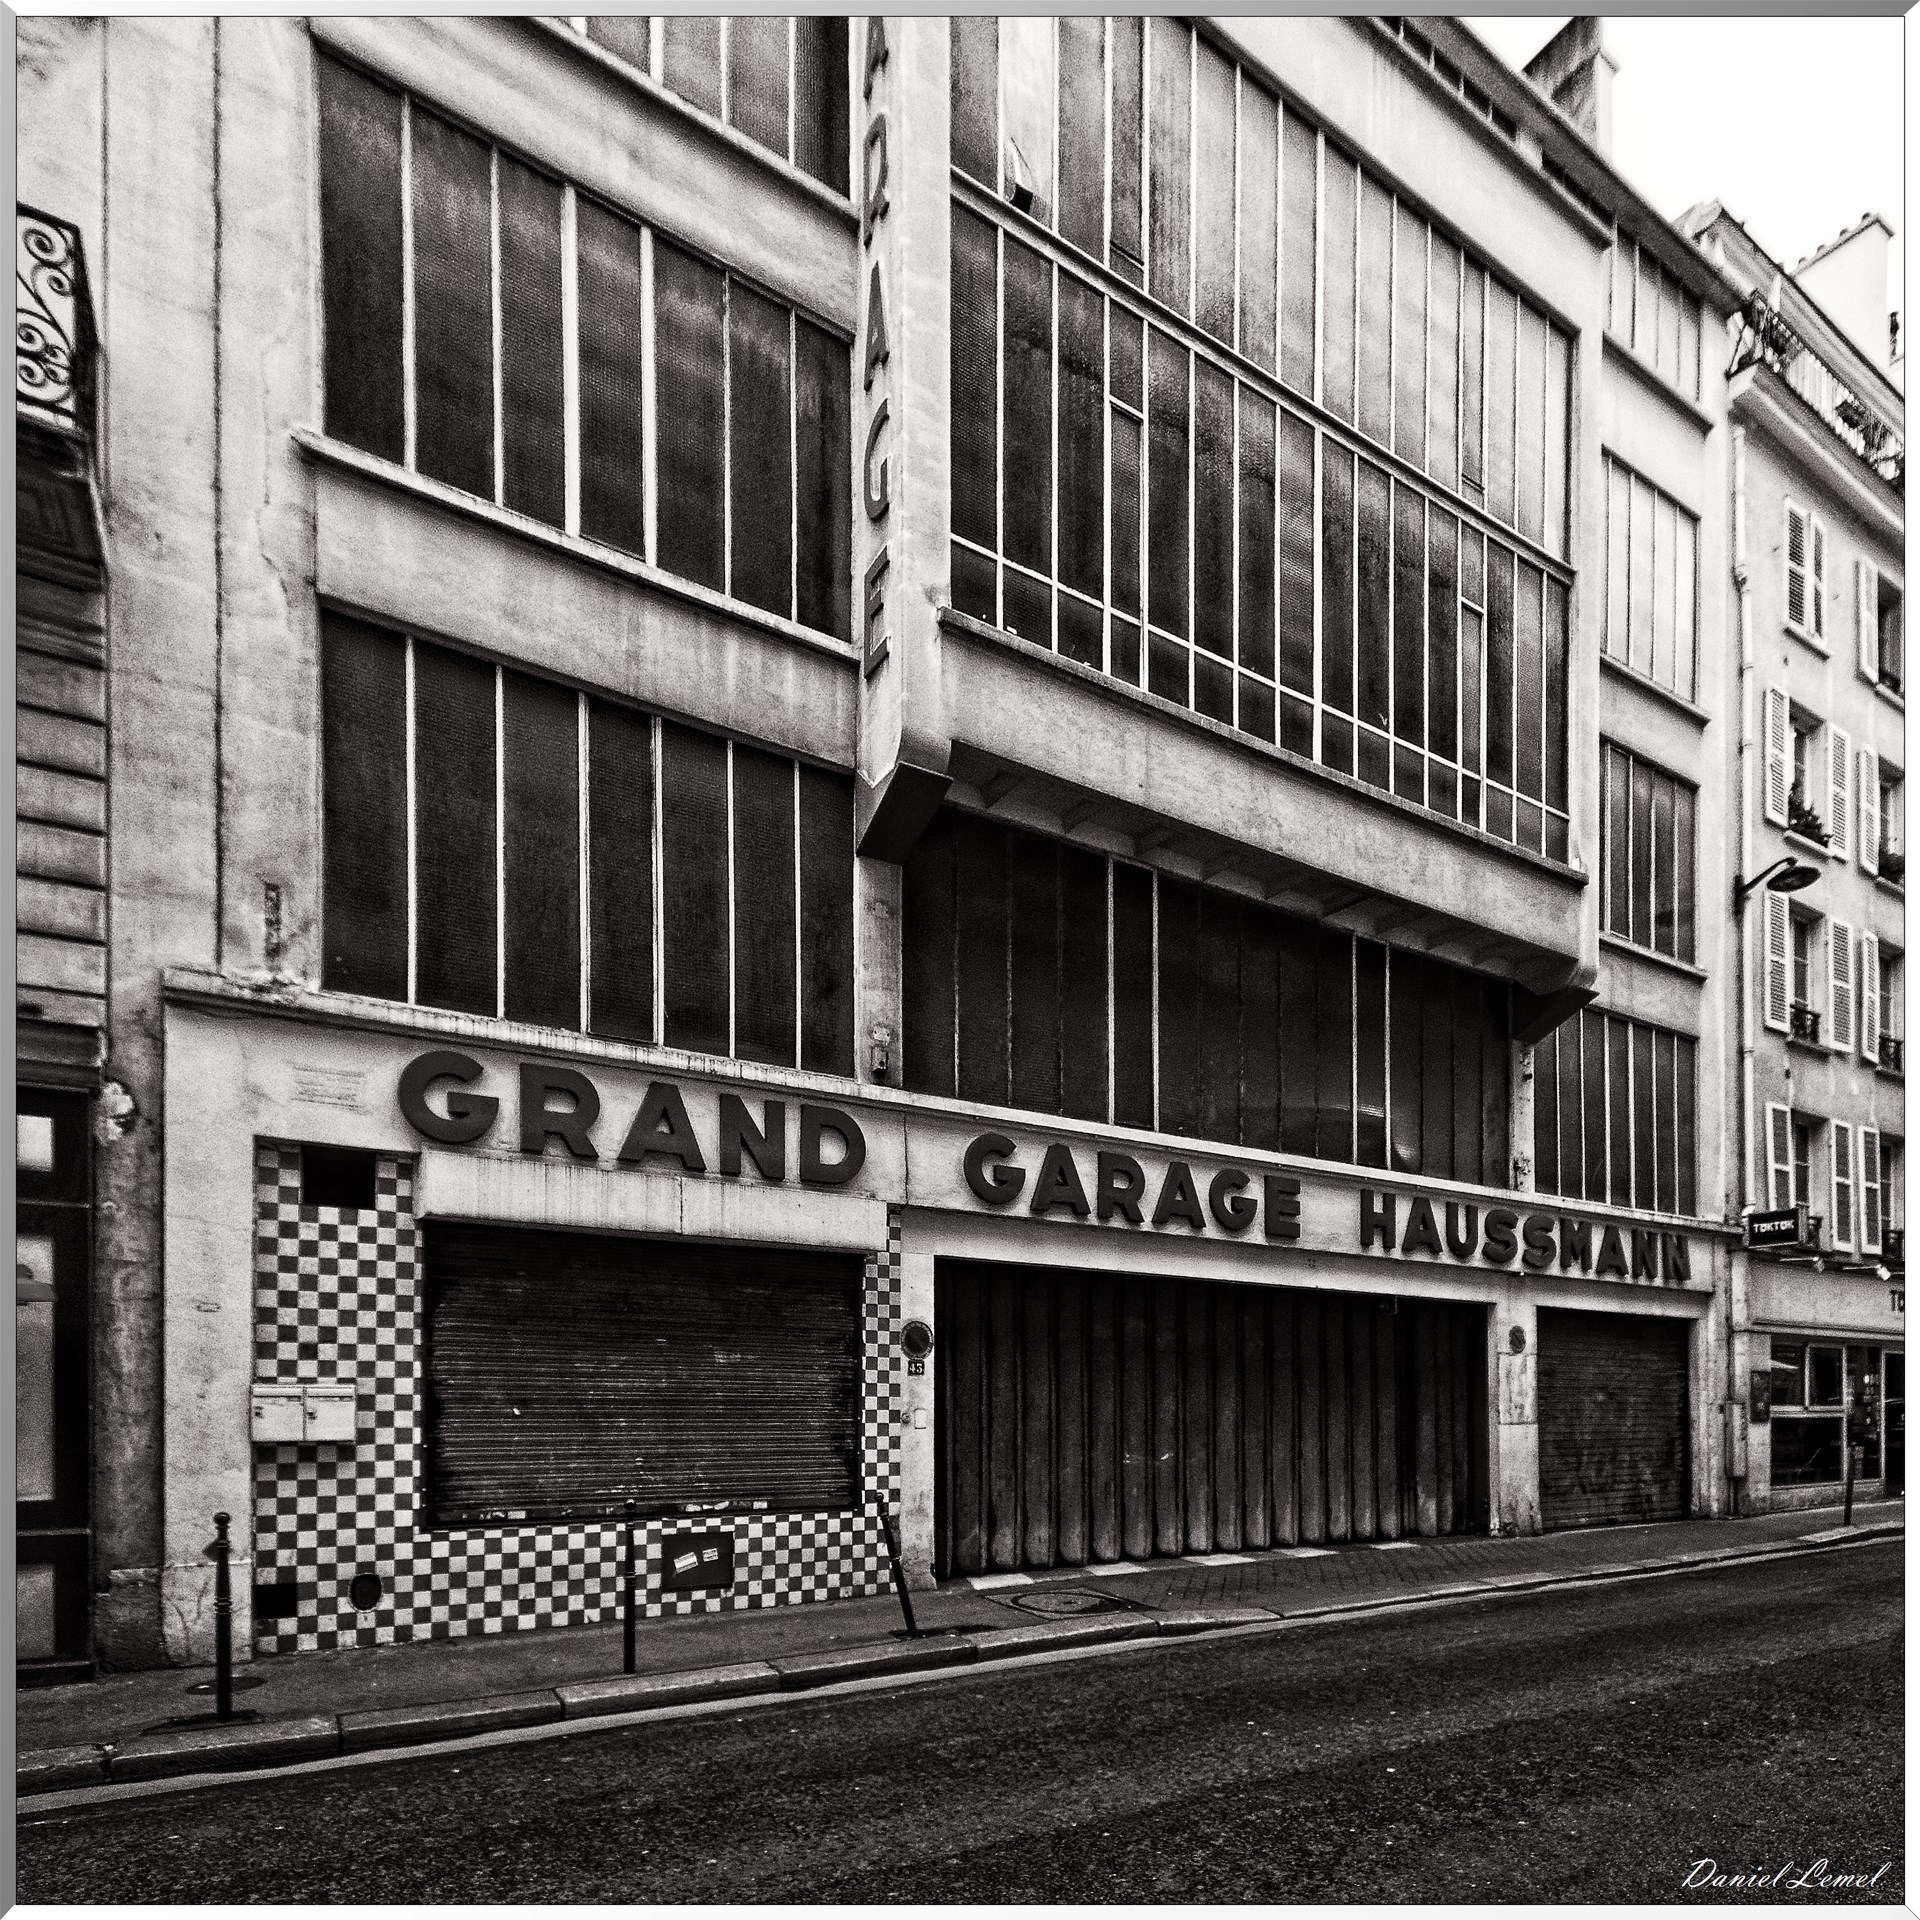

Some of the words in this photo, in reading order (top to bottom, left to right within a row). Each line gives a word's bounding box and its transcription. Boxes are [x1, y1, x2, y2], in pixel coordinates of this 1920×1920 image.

[399, 1050, 867, 1185] GRAND
[963, 1132, 1302, 1239] GARAGE
[1360, 1189, 1692, 1282] HAUSSMANN
[1753, 1219, 1795, 1233] TOKTOK
